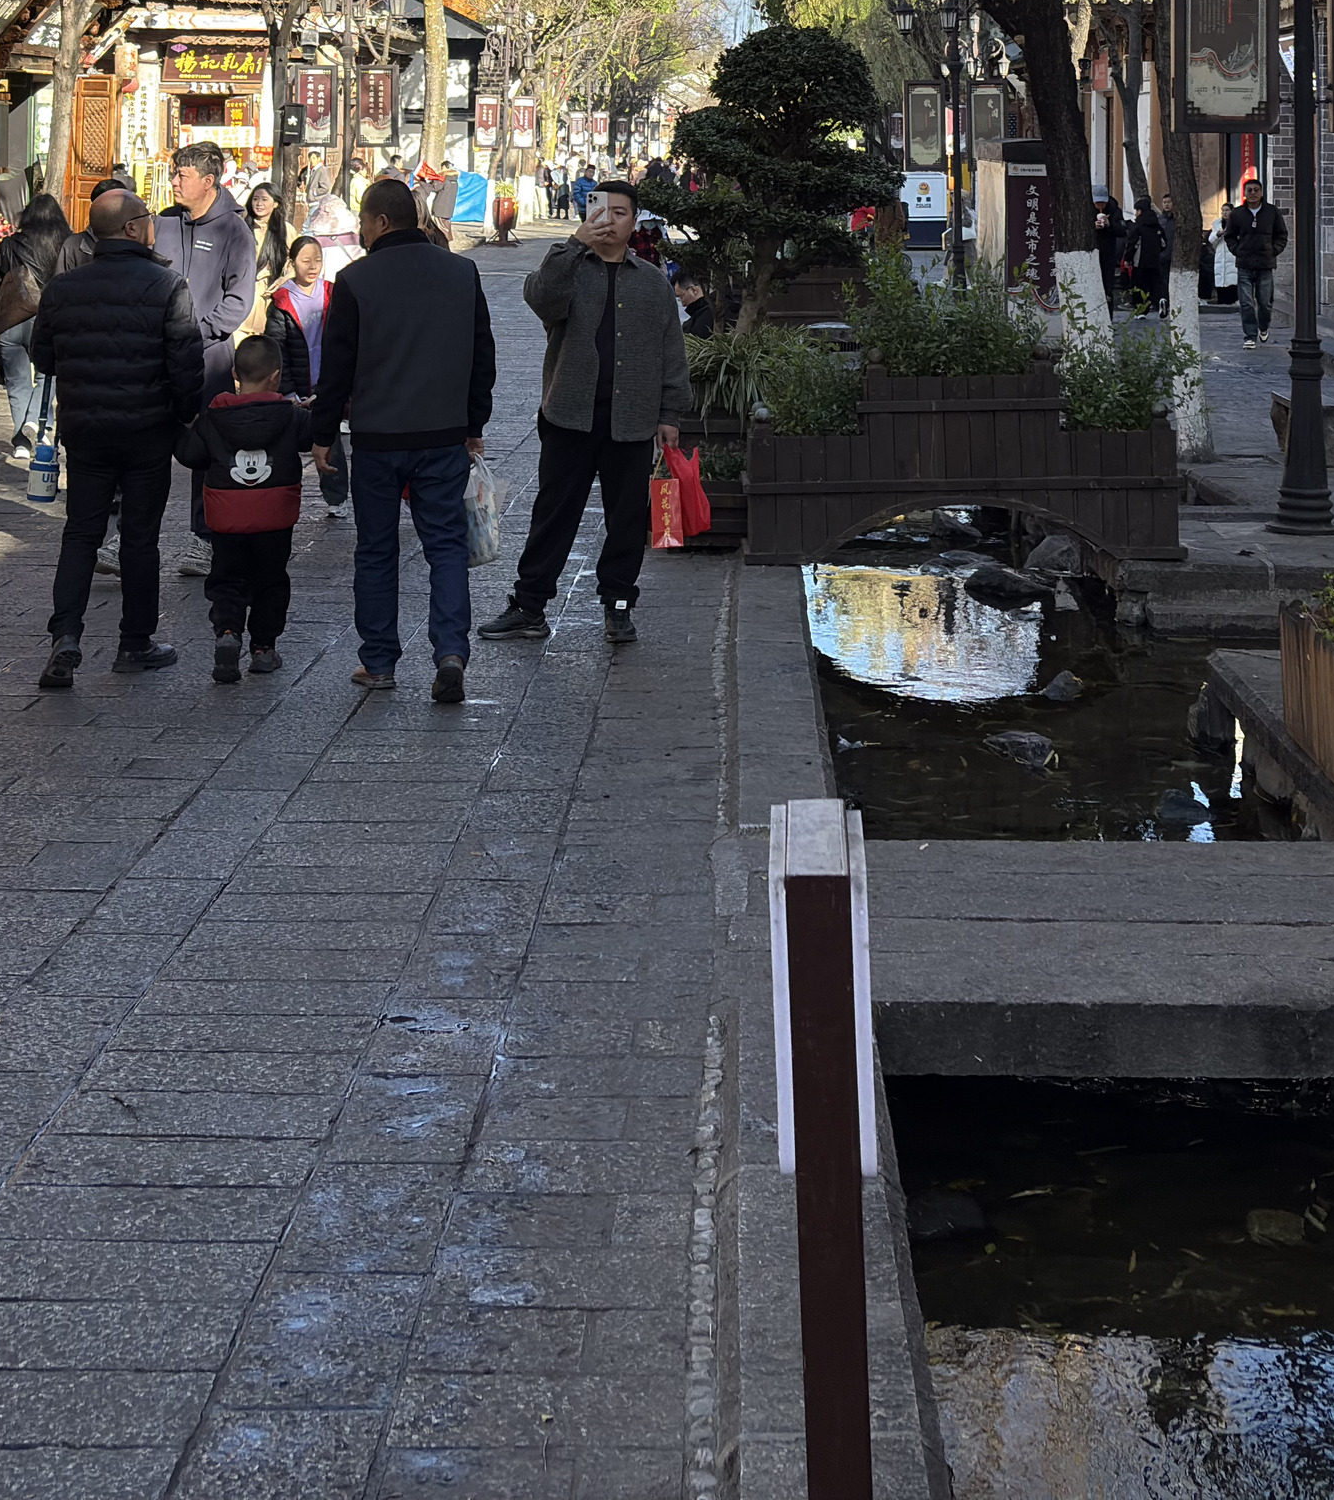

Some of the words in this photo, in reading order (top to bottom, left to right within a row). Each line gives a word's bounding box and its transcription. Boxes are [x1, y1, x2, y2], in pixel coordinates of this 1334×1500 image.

[317, 83, 325, 113] 你我同行
[1025, 184, 1041, 281] 文明是城市之魂
